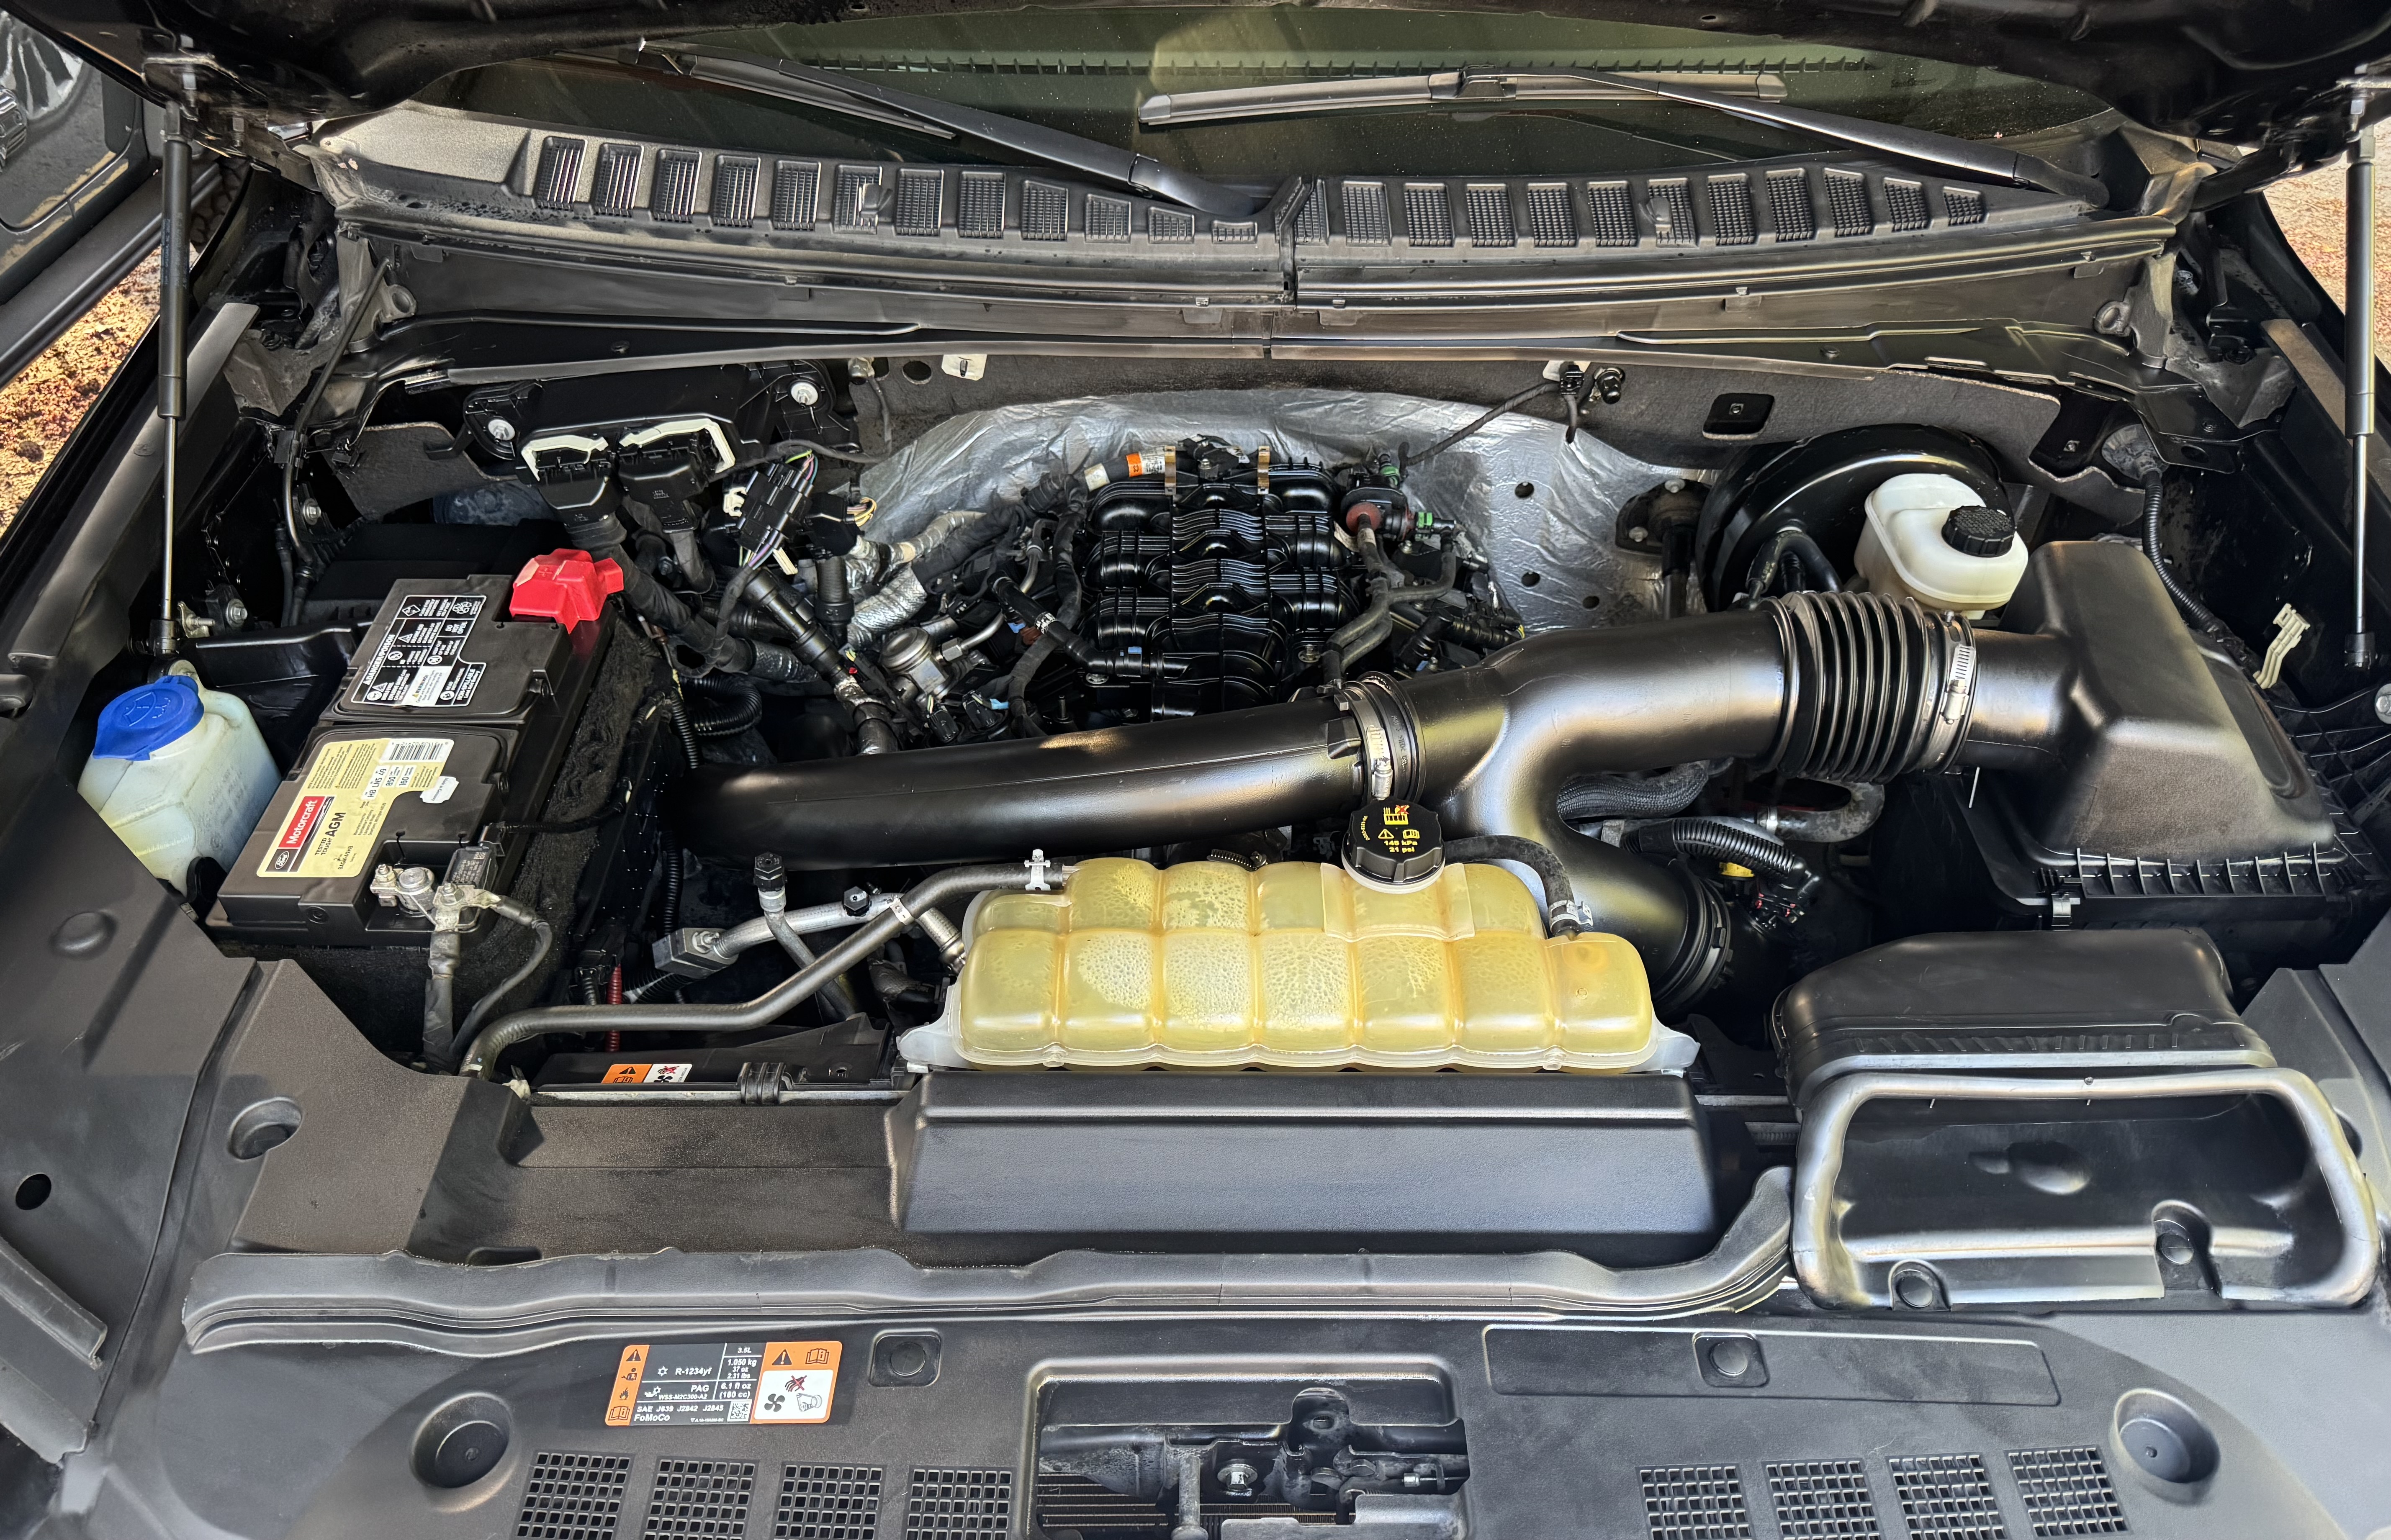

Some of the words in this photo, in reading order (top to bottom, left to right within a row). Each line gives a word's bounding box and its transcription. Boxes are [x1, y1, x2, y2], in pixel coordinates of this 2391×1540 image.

[451, 624, 460, 633] NOT
[365, 634, 396, 680] DANGER/POISON
[385, 776, 396, 785] 850
[398, 777, 409, 785] 160
[285, 799, 318, 844] Motorcraft
[323, 812, 346, 837] AGM
[314, 838, 327, 855] TESTED
[275, 854, 289, 866] Ford
[675, 1368, 712, 1376] R-1234yf
